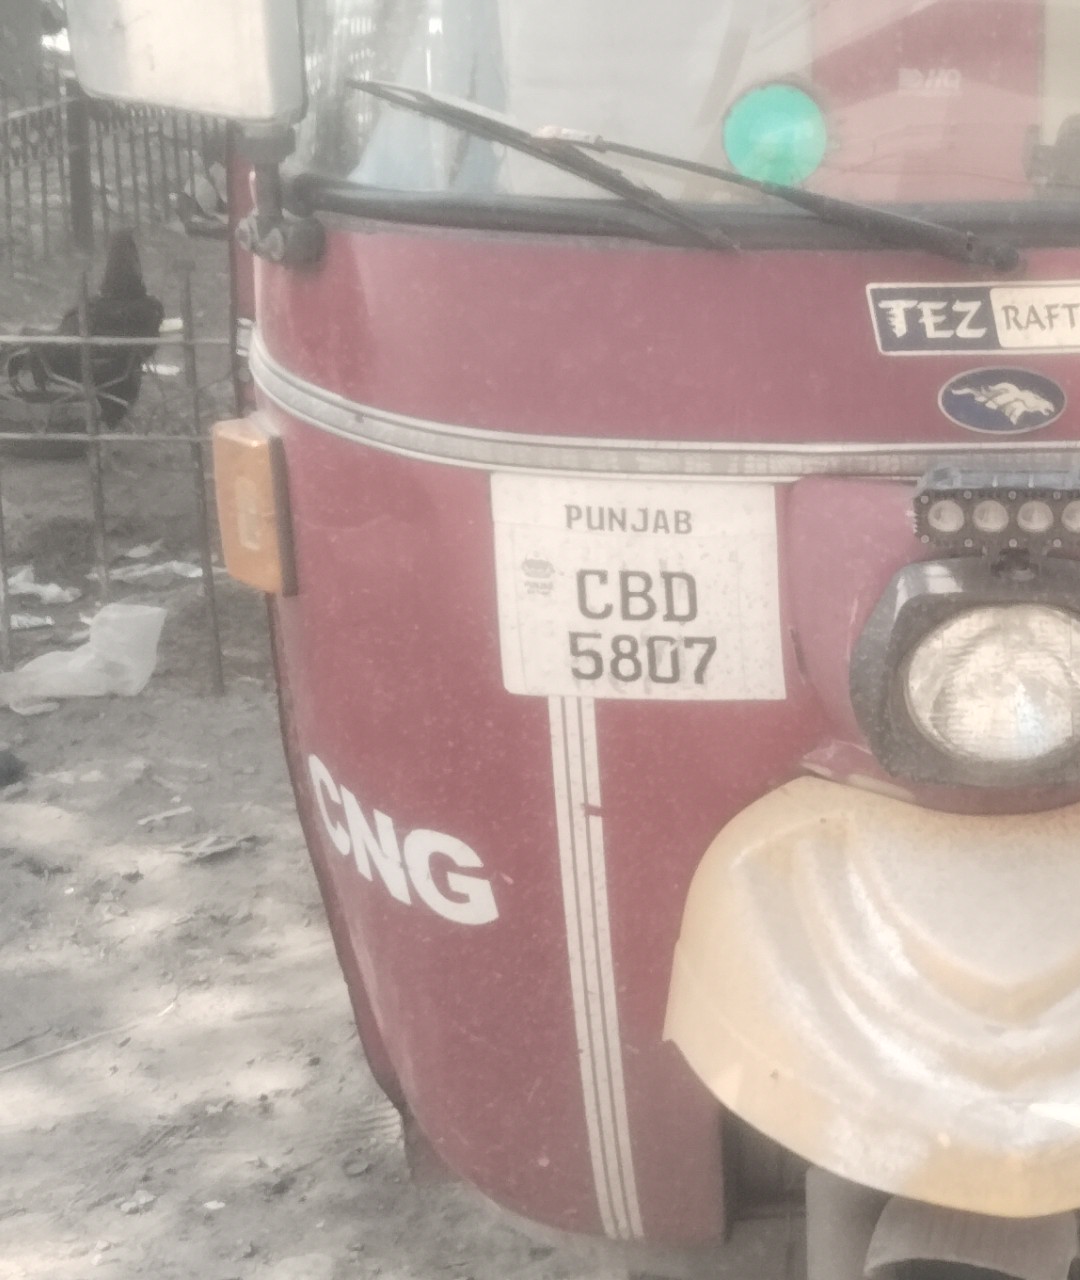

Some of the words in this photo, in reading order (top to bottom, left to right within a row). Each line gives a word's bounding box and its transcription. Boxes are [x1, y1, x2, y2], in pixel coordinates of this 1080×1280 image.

[878, 299, 988, 339] TEZ
[564, 504, 693, 535] PUNJAB
[576, 569, 698, 623] CBD
[568, 631, 717, 685] 5807
[308, 753, 500, 926] CNG
